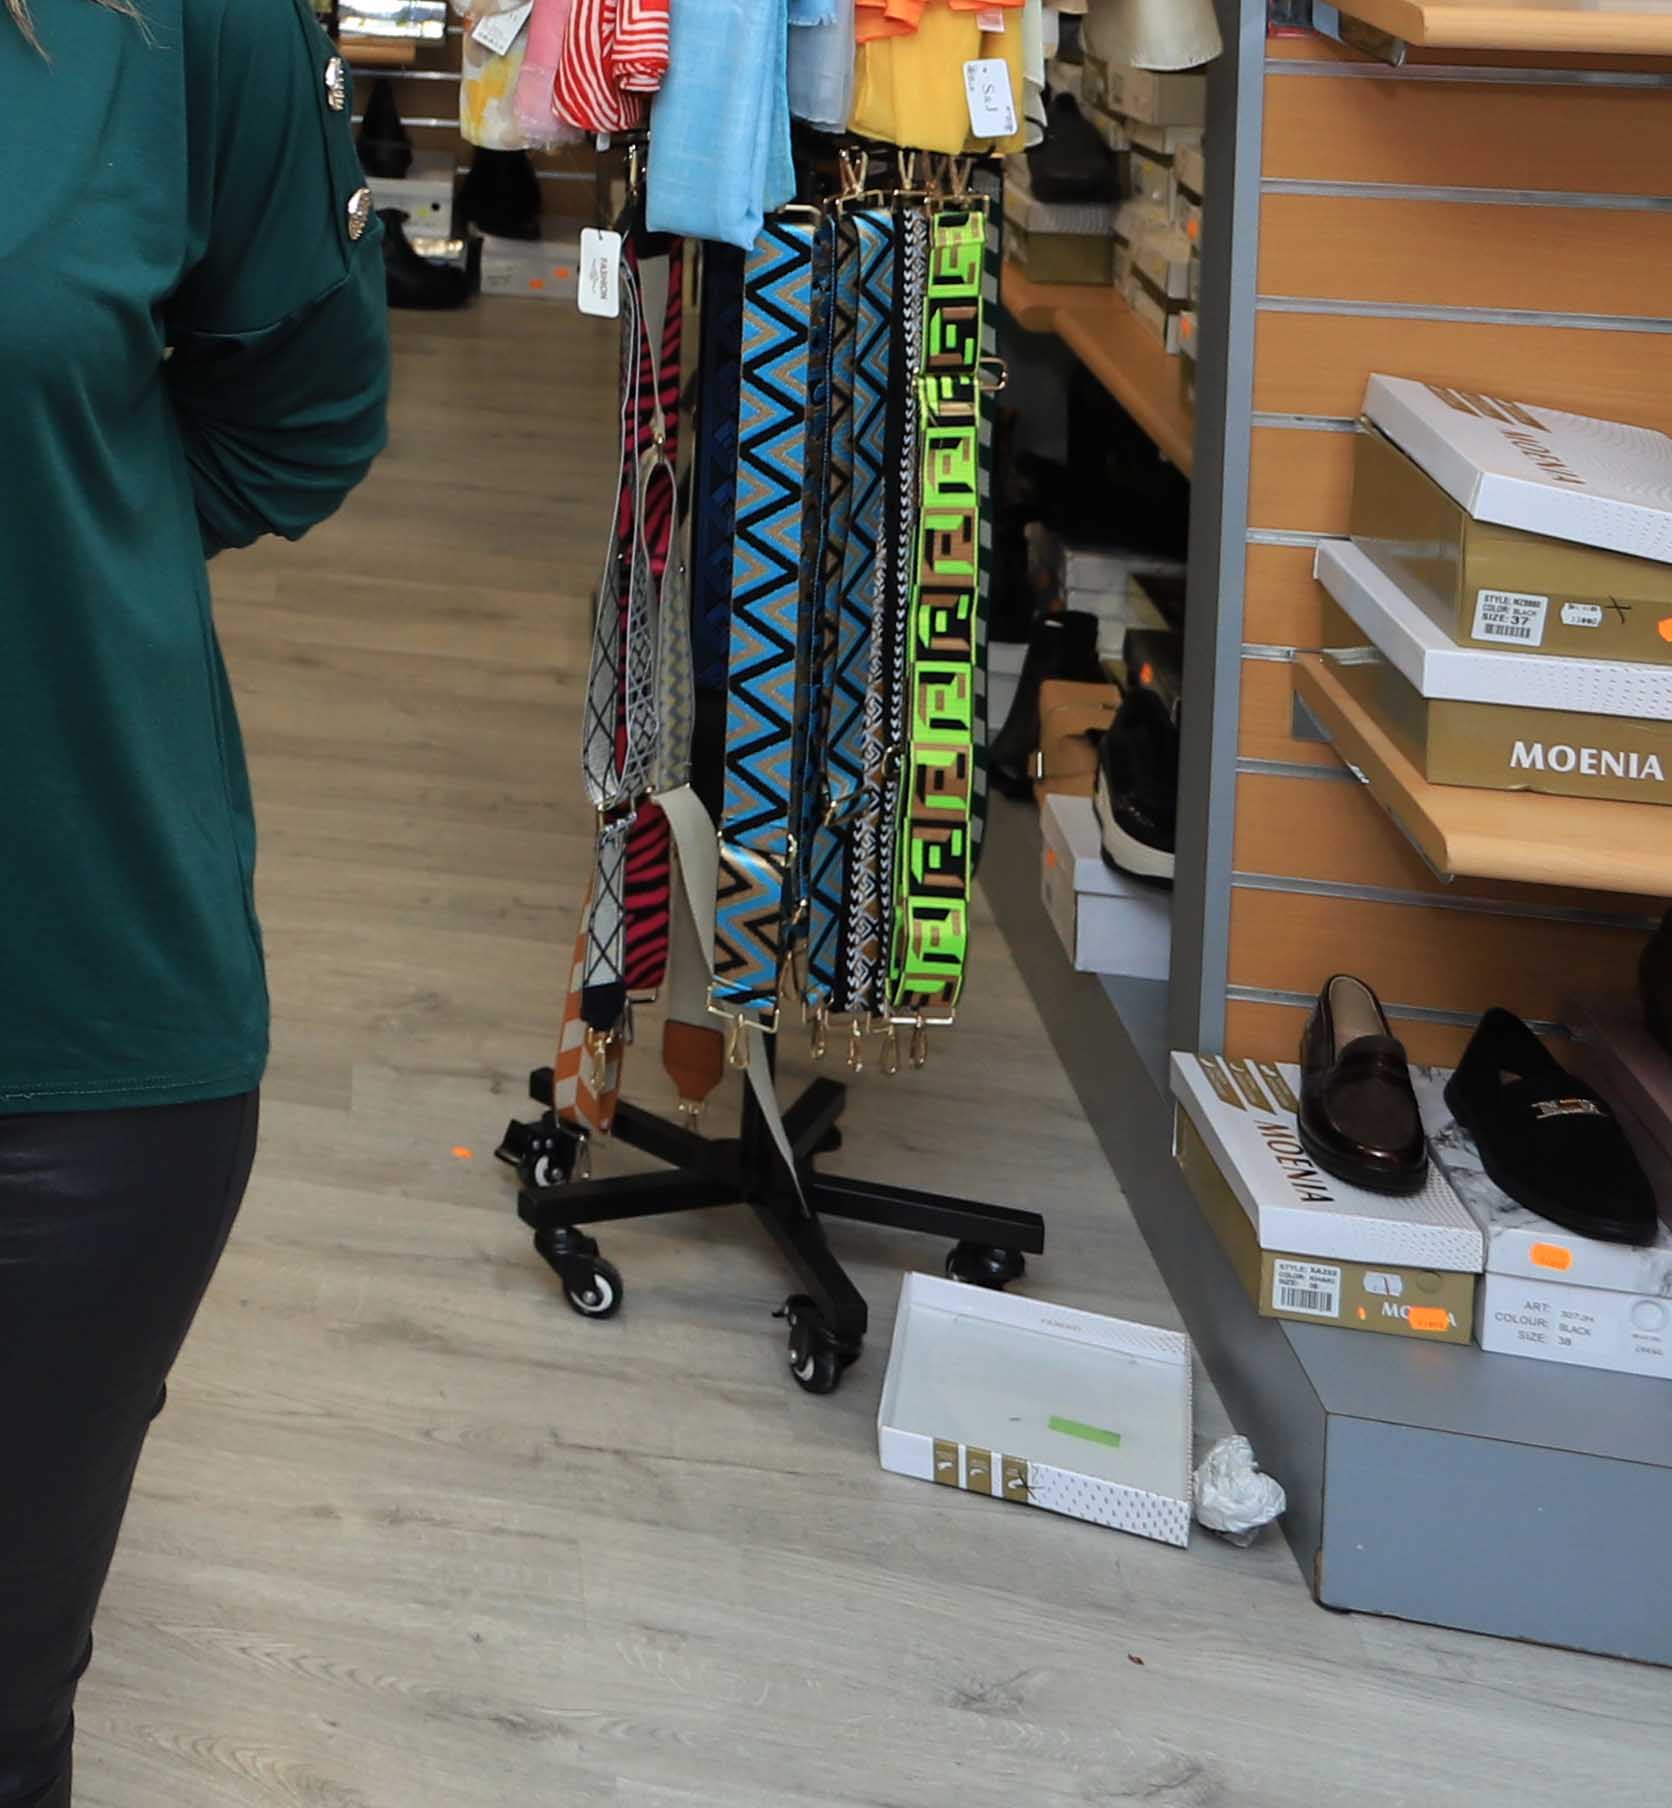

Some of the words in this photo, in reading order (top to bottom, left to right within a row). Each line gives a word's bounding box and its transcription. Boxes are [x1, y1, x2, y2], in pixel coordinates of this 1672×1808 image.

[1510, 615, 1529, 625] 37
[1509, 741, 1665, 781] MOENIA
[1253, 1119, 1335, 1202] MOENIA
[1494, 1311, 1549, 1328] COLOUR:
[1558, 1323, 1591, 1336] BLACK
